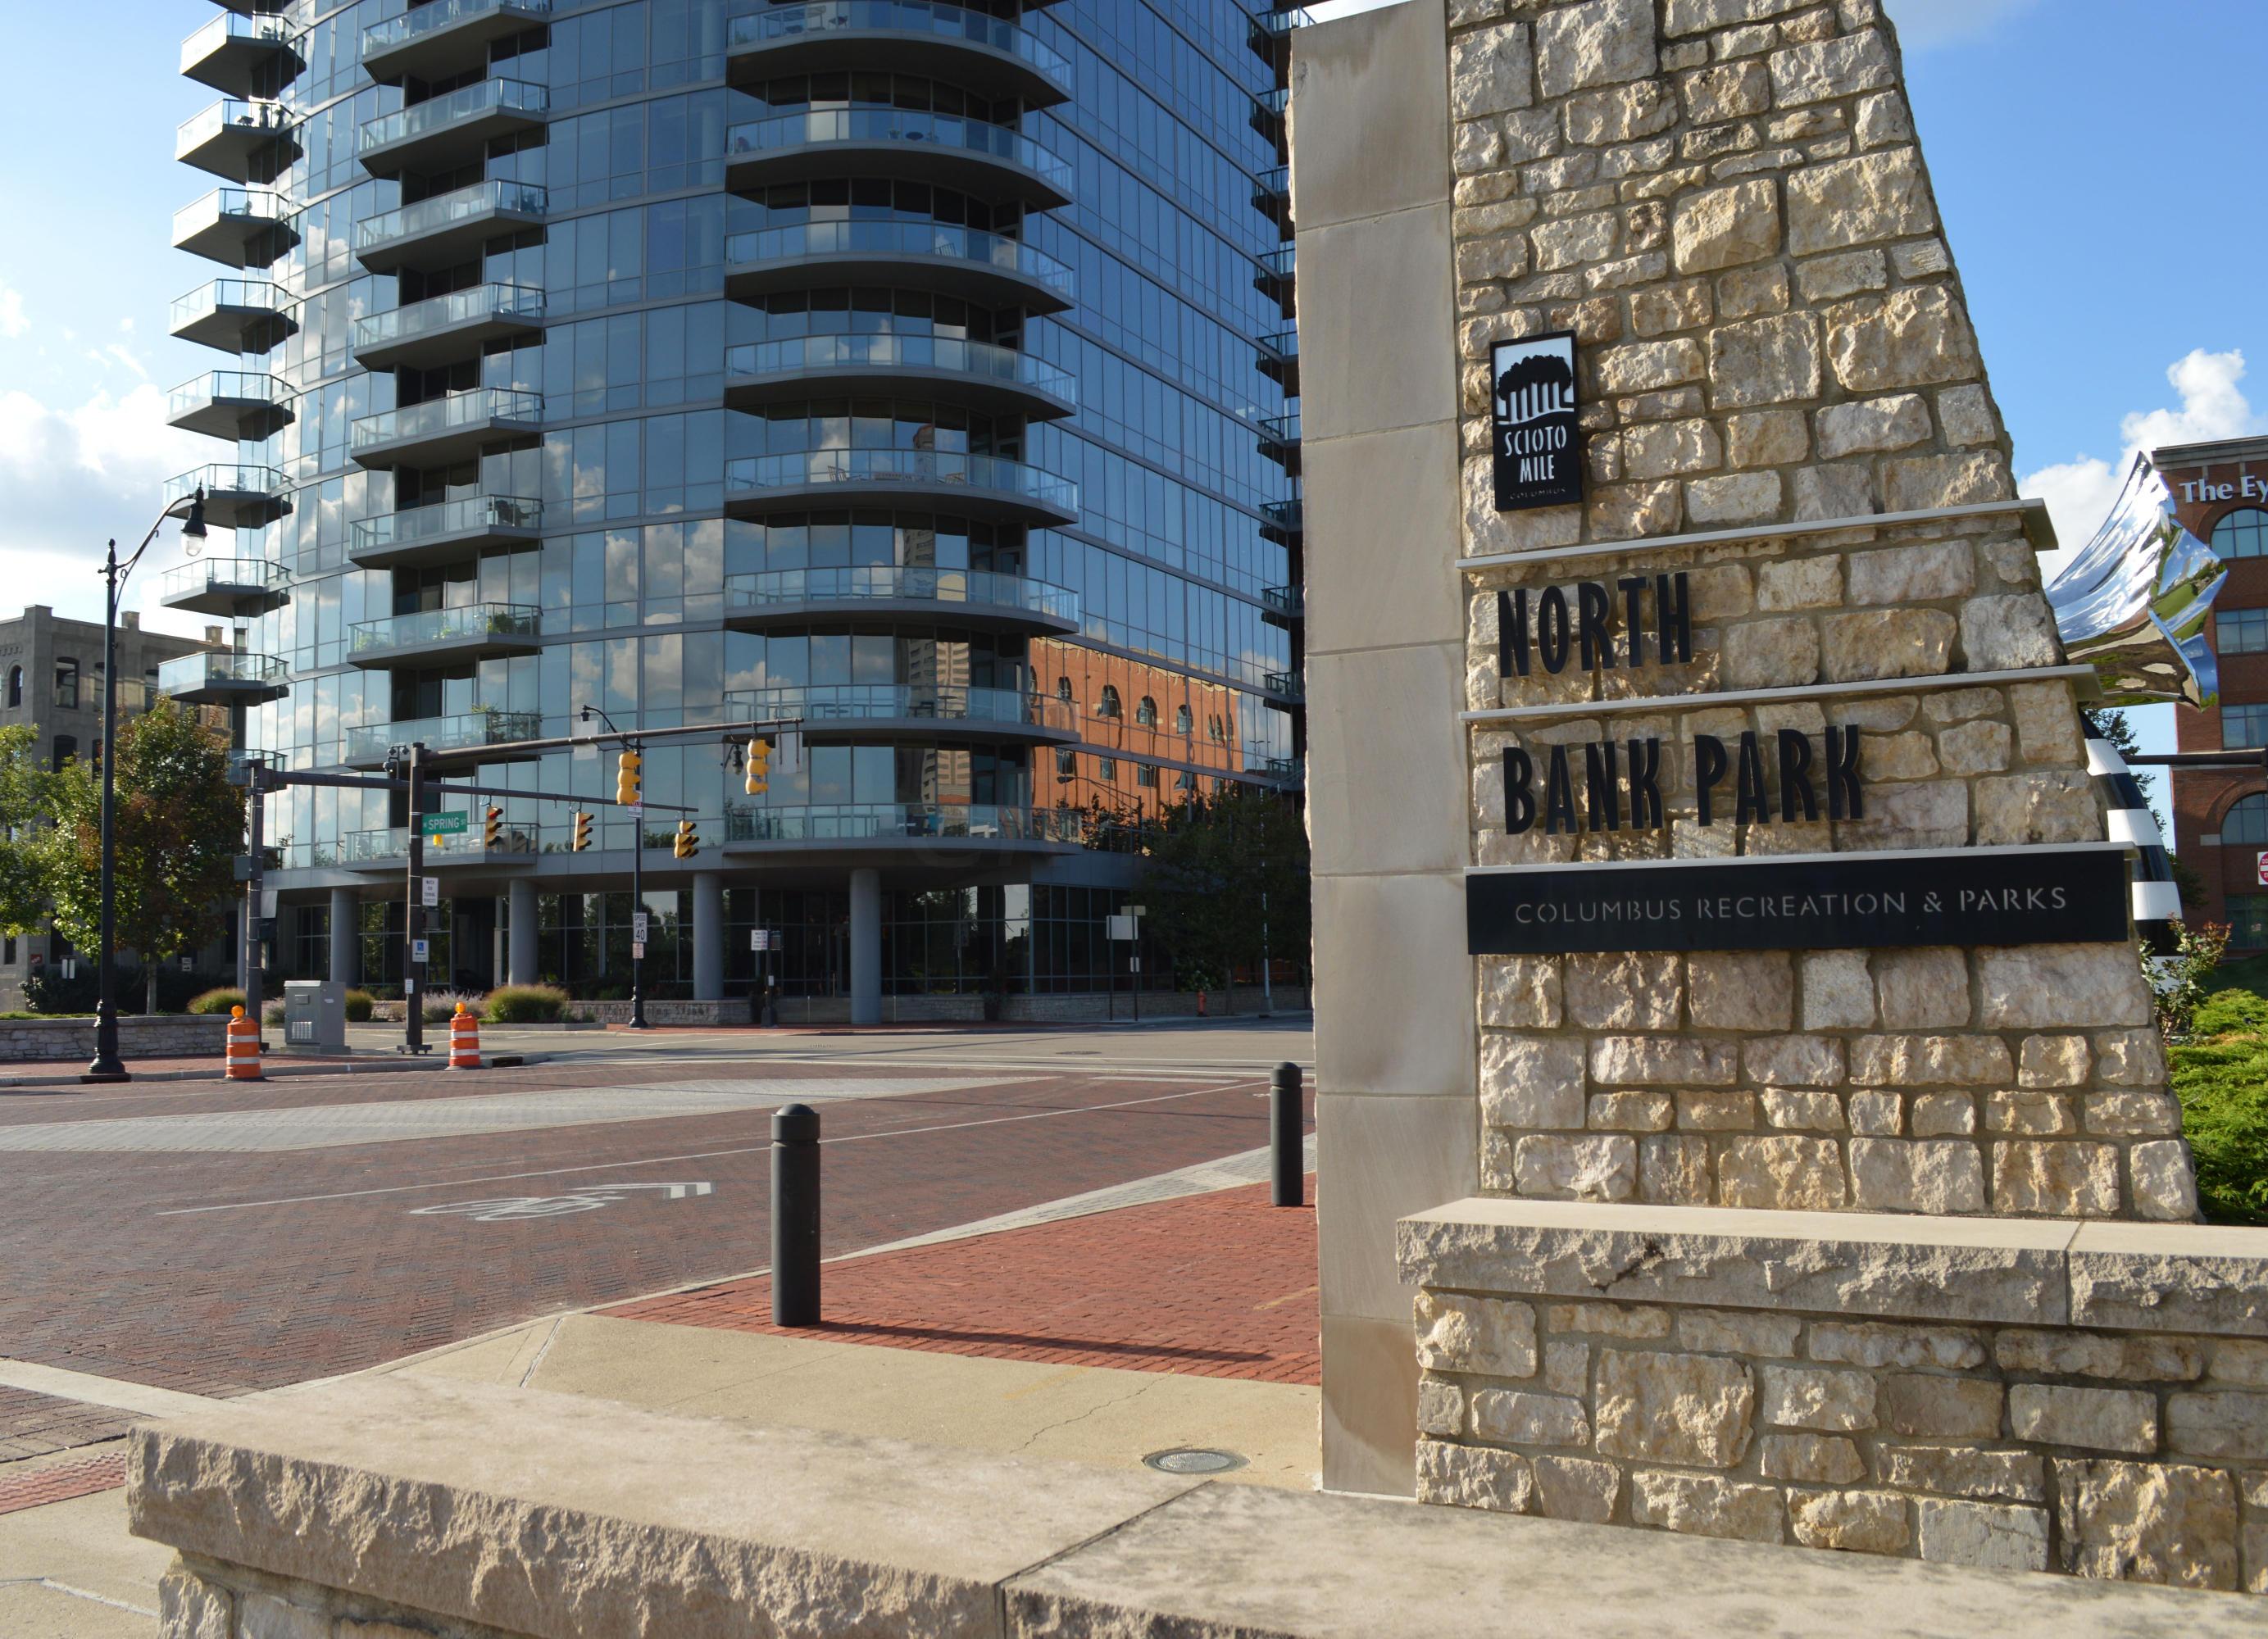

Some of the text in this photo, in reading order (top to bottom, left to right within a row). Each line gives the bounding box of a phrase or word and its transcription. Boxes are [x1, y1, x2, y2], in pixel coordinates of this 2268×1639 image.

[1505, 425, 1566, 456] SCIOTO
[1520, 454, 1555, 483] MILE
[2178, 478, 2234, 503] The
[1498, 572, 1693, 678] NORTH
[1502, 724, 1863, 836] BANK PARK
[428, 817, 460, 830] SPRING
[1516, 887, 2066, 924] COLUMBUS RECREATION & PARKS
[635, 929, 645, 941] 40
